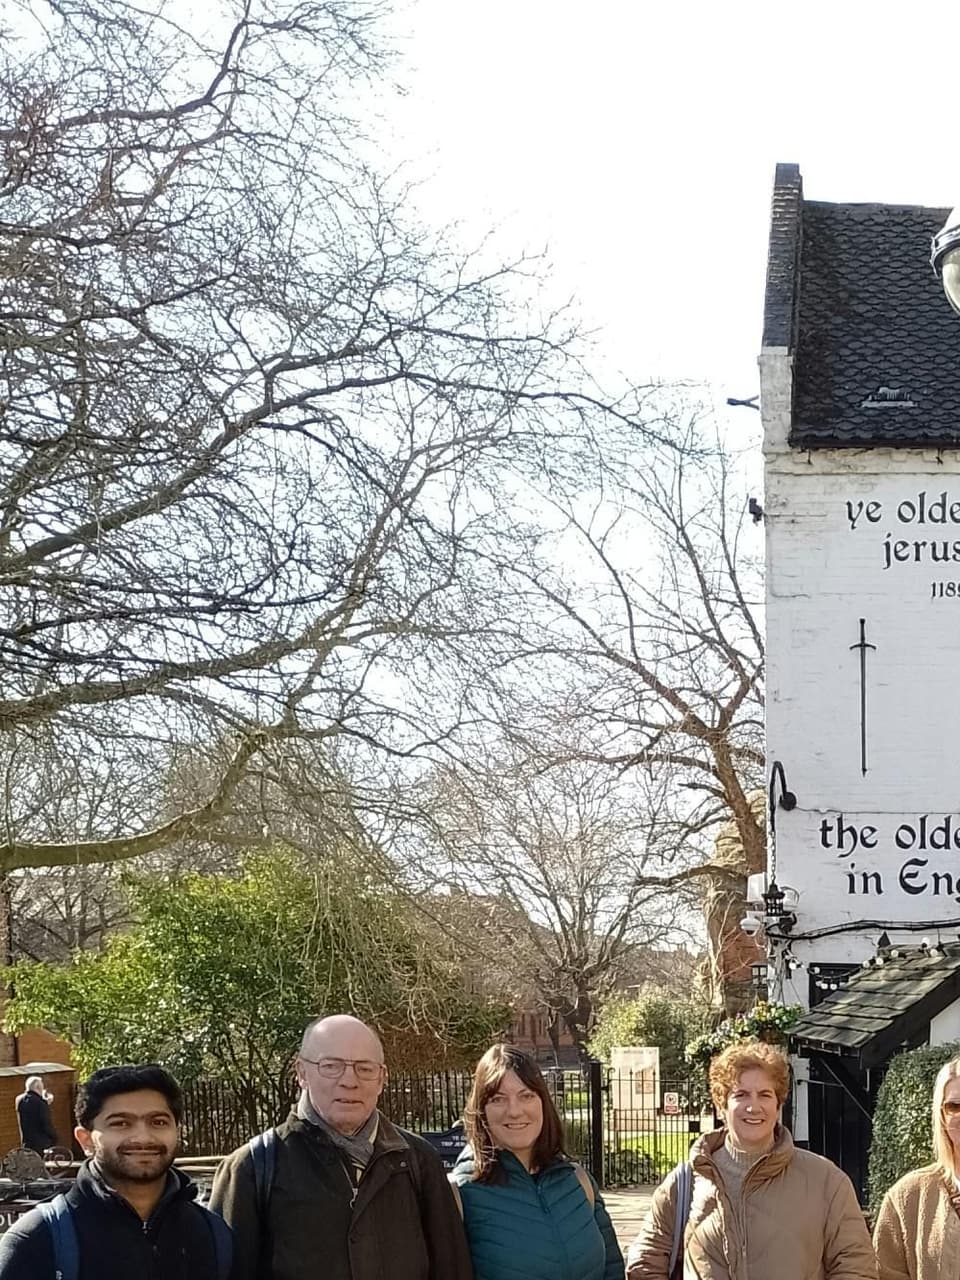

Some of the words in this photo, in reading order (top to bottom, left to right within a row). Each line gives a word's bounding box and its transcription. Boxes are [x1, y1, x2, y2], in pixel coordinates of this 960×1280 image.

[846, 500, 882, 530] ye
[819, 814, 878, 858] the
[848, 863, 884, 895] in
